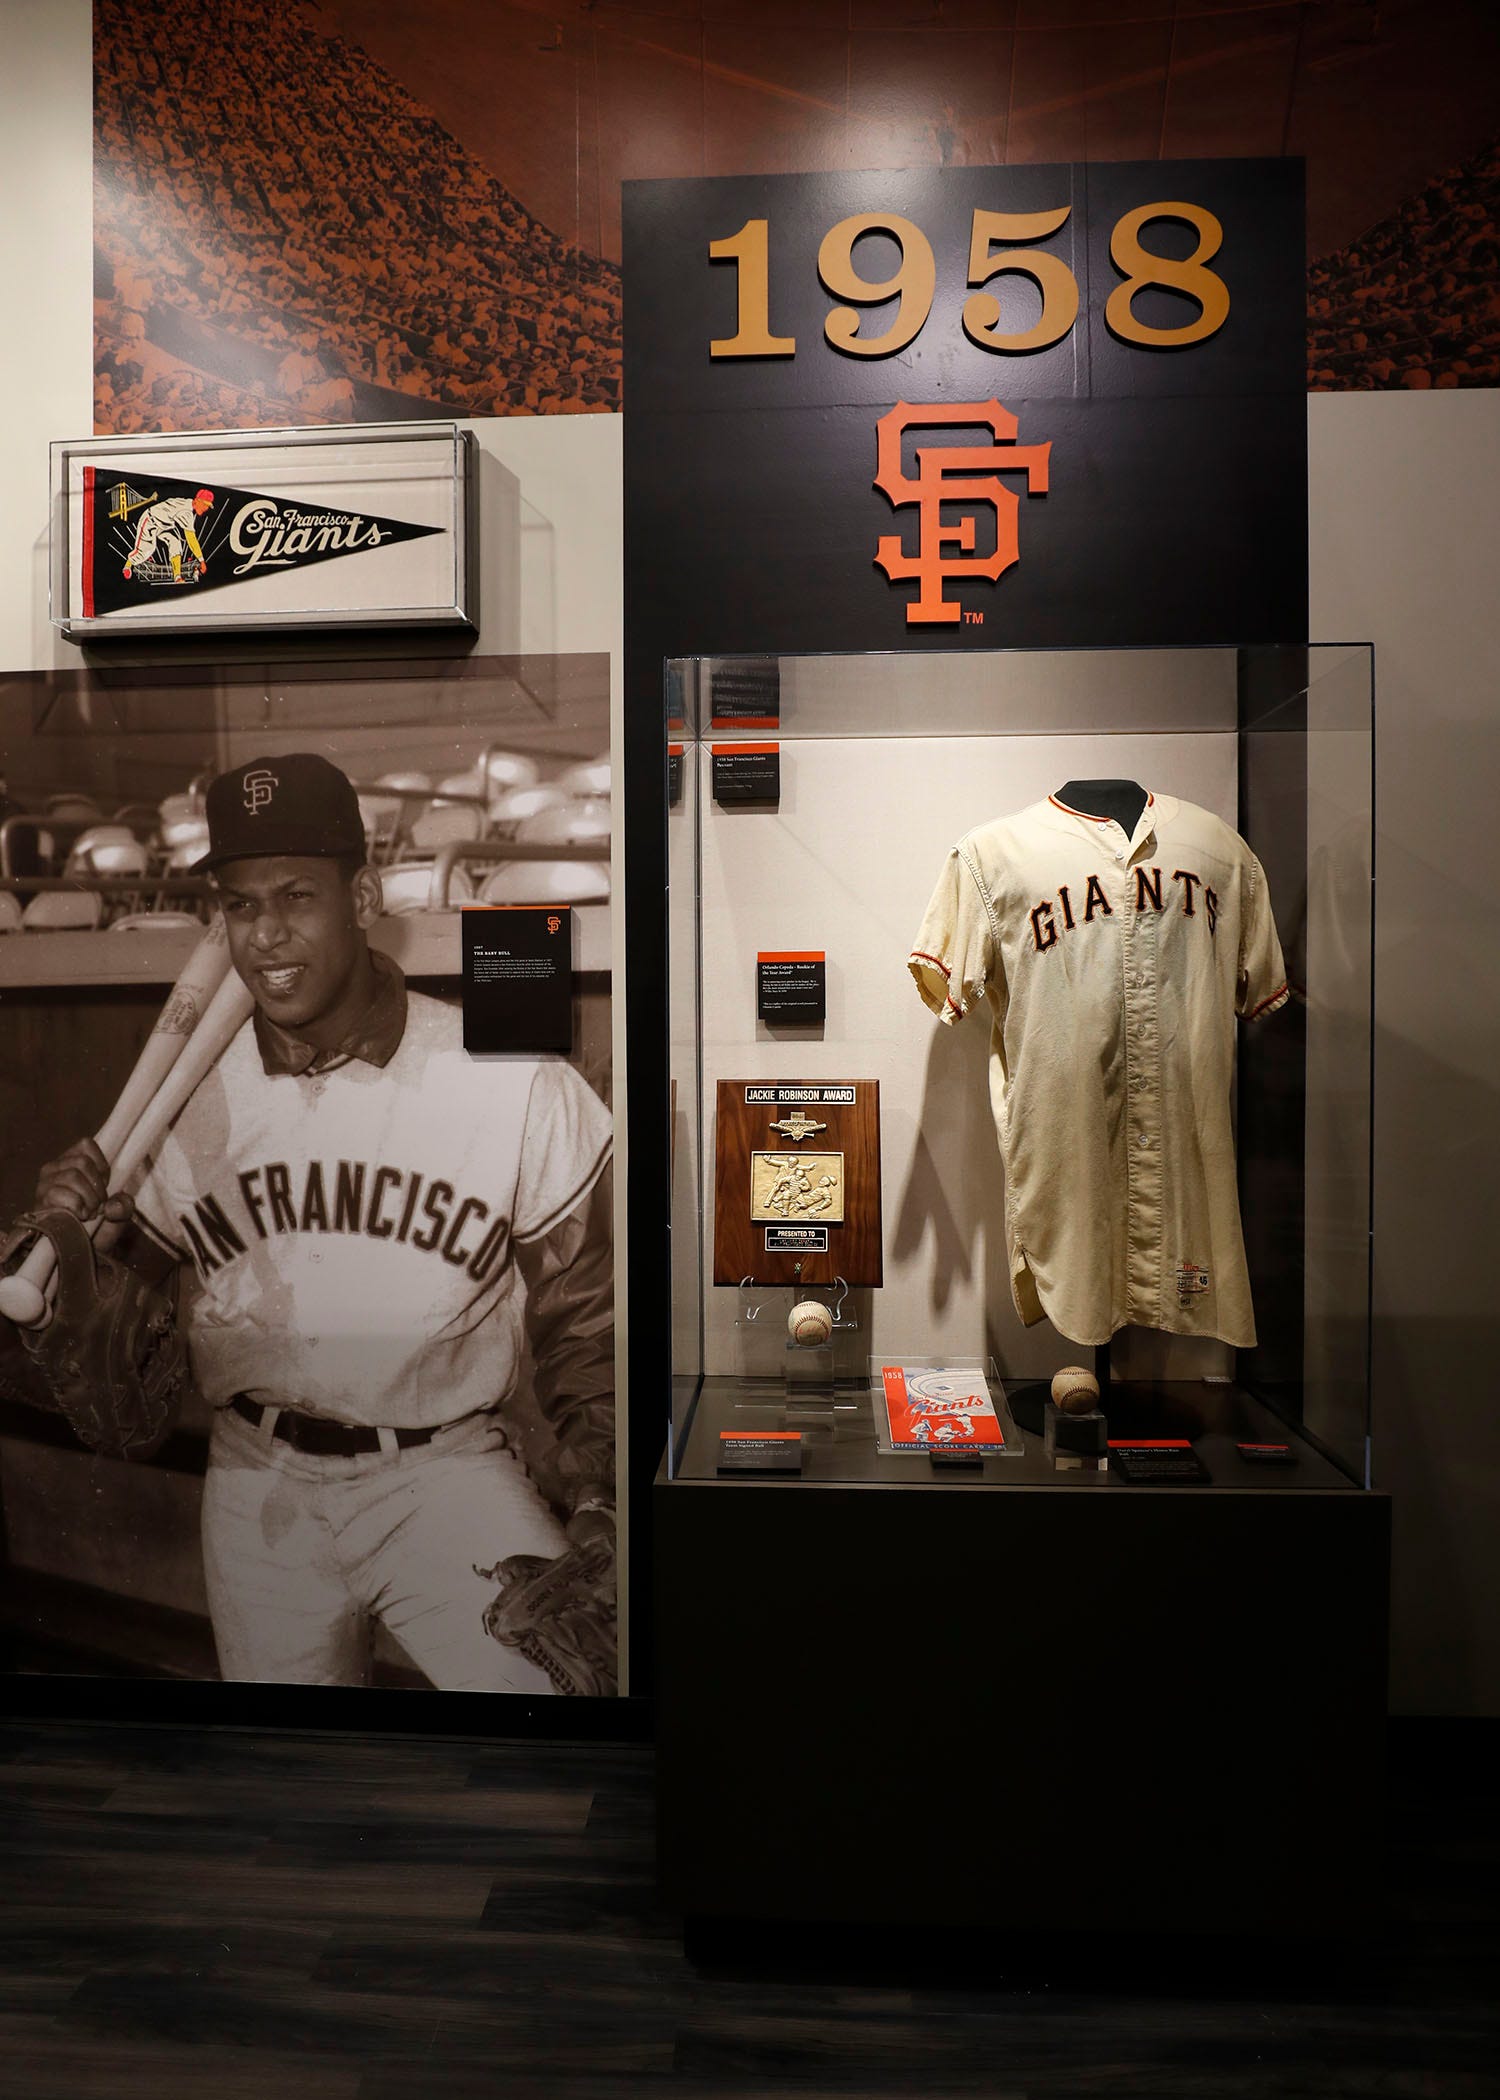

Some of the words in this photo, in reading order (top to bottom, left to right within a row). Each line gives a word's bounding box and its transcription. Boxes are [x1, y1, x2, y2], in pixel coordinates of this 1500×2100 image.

[709, 201, 1230, 356] 1958
[229, 499, 393, 575] Giants
[246, 510, 282, 534] San
[283, 509, 348, 531] Francisco
[872, 396, 1053, 623] SF
[963, 612, 984, 624] TM
[243, 769, 279, 816] SF
[1029, 866, 1219, 955] GIANTS
[748, 1090, 775, 1100] JACKIE
[779, 1090, 820, 1100] ROBINSON
[823, 1090, 852, 1101] AWARD
[178, 1192, 248, 1281] AN
[237, 1159, 513, 1284] FRANCISCO
[904, 1395, 984, 1428] Giants
